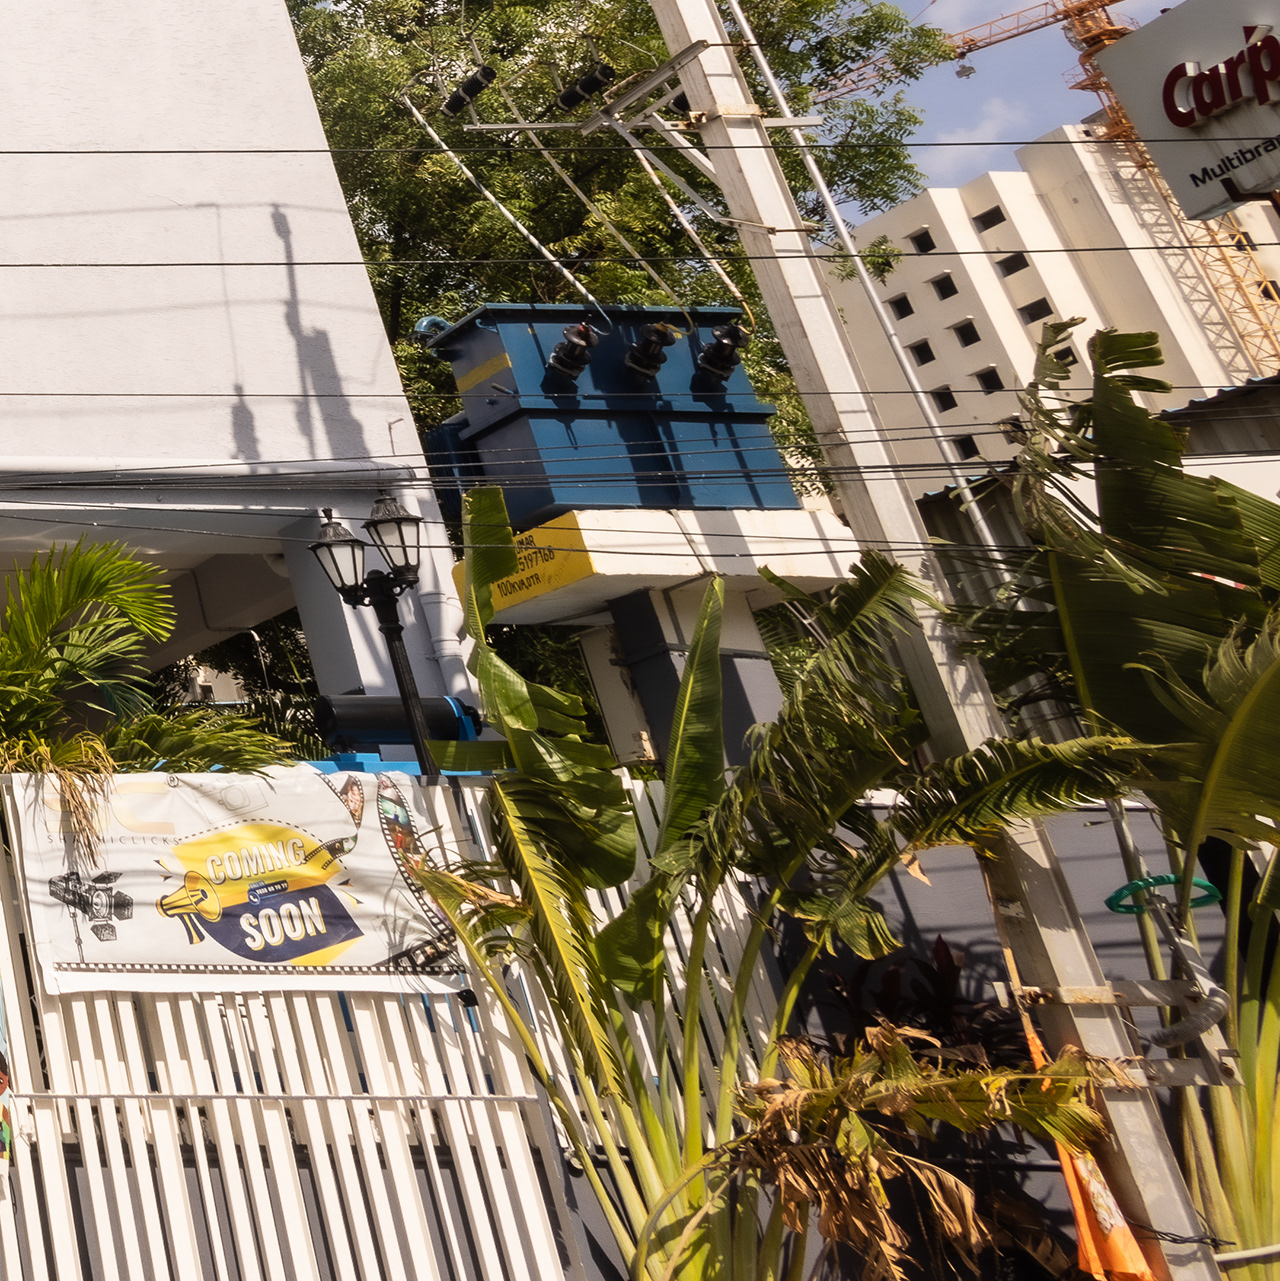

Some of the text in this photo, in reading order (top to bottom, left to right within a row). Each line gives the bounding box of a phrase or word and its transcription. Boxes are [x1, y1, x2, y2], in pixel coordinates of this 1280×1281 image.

[513, 535, 536, 554] UMAR
[206, 838, 307, 885] COMING
[240, 897, 327, 950] SOON
